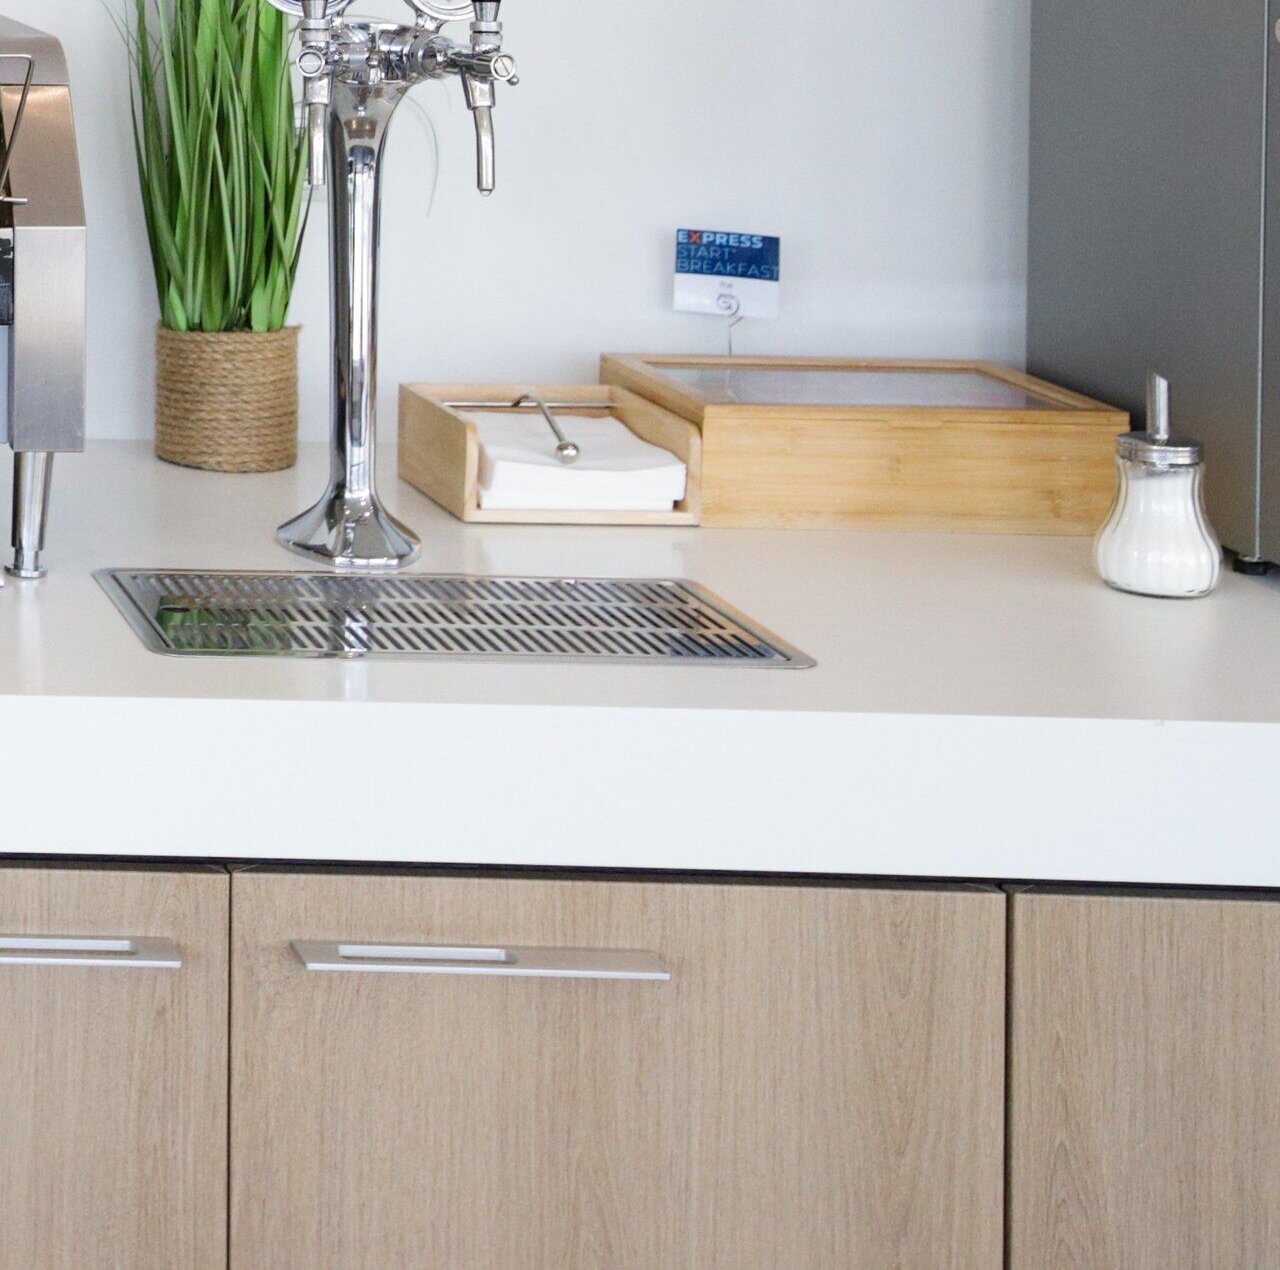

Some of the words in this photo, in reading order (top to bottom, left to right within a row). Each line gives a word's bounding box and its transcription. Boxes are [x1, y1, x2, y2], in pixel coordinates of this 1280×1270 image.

[677, 231, 764, 249] EXPRESS
[677, 243, 732, 260] START
[677, 258, 779, 280] BREAKFAST
